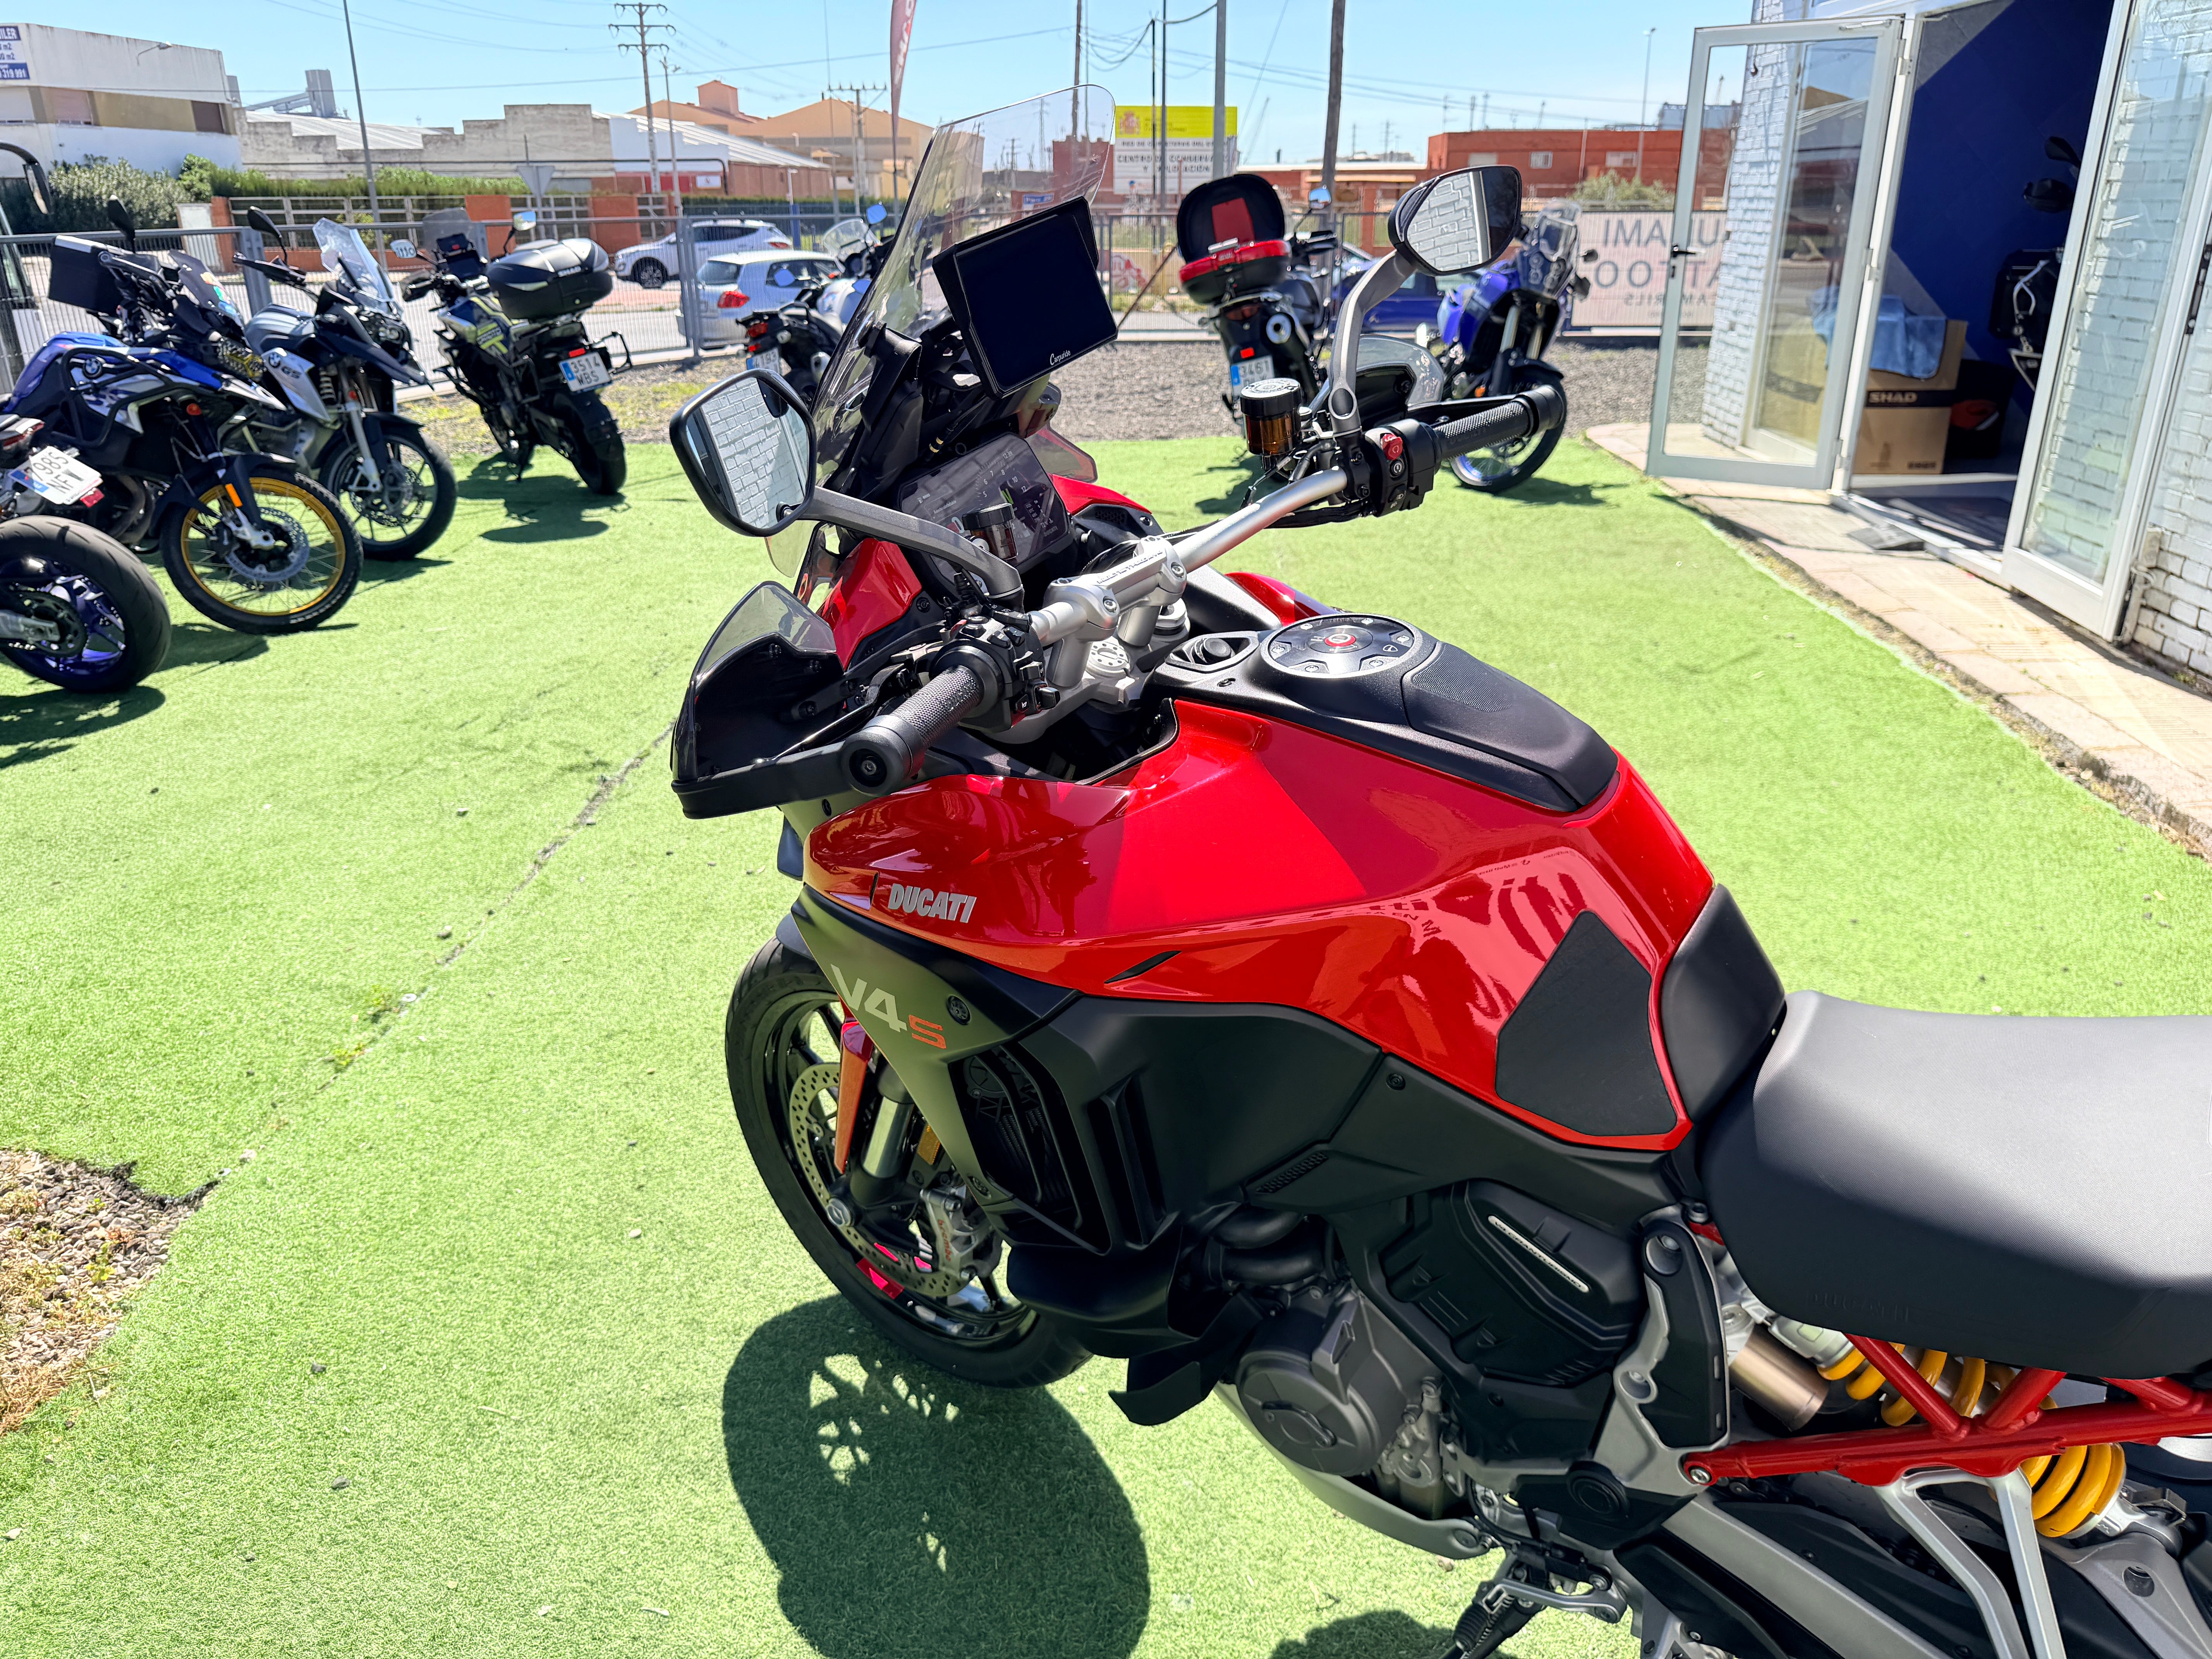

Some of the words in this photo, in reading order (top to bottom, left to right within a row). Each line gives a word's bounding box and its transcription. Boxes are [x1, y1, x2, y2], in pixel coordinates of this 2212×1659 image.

[571, 356, 600, 373] 3514
[1050, 350, 1071, 366] Carpuride
[1869, 391, 1917, 404] SHAD
[888, 883, 977, 924] DUCATI
